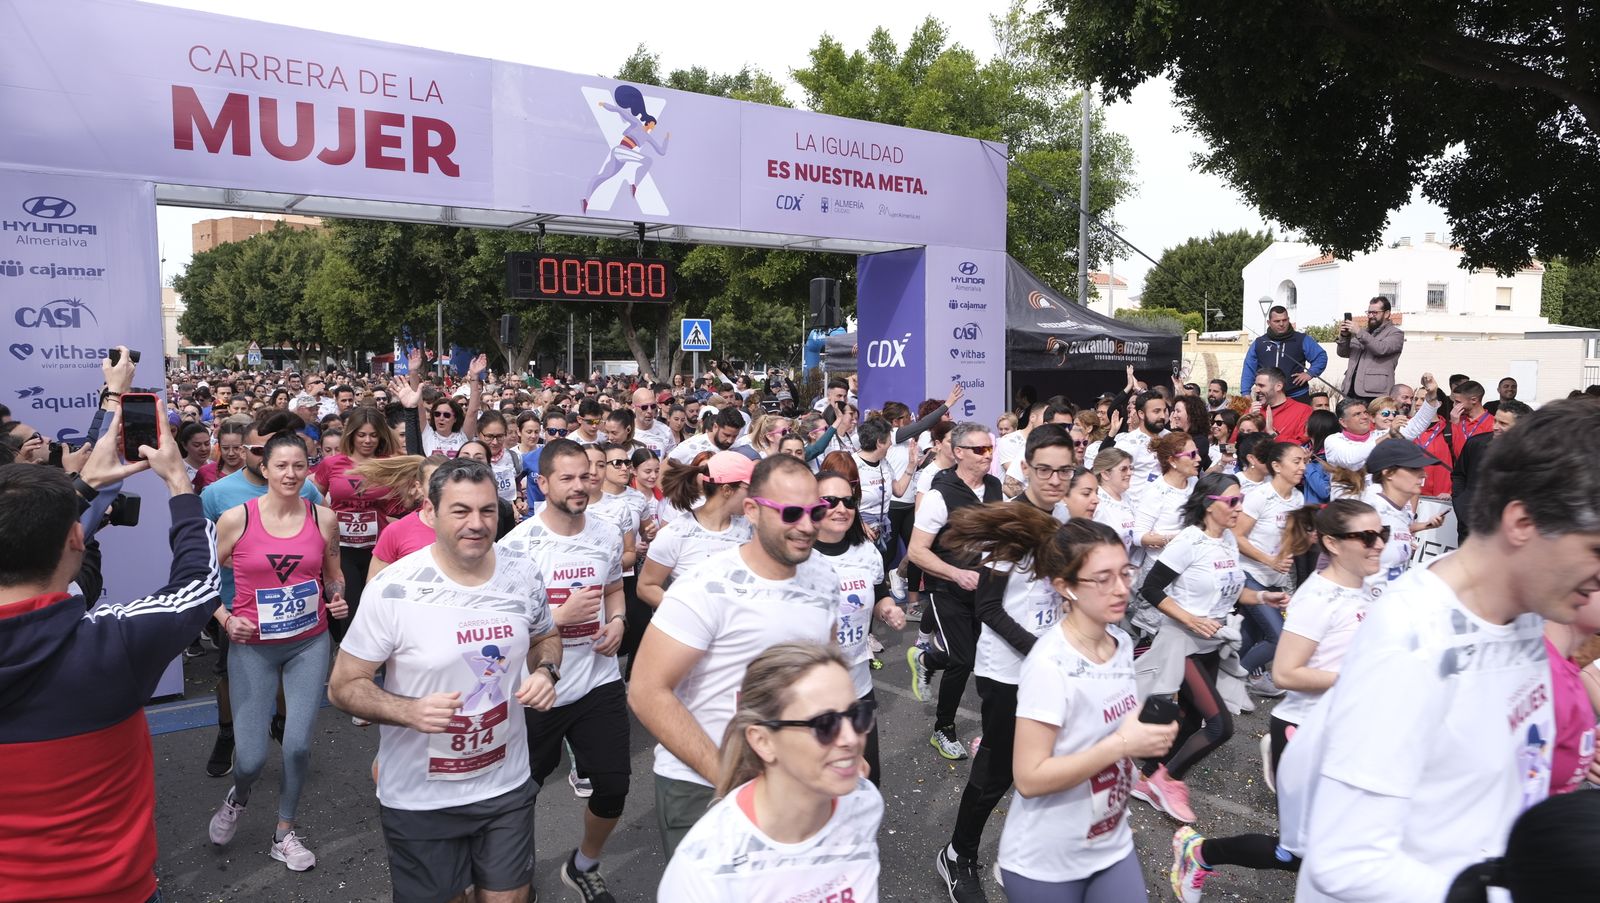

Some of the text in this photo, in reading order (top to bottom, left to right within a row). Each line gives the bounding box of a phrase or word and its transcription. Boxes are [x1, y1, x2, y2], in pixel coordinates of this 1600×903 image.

[188, 45, 444, 104] CARRERA DE LA
[172, 85, 460, 177] MUJER
[796, 132, 904, 164] LA IGUALDAD
[767, 159, 928, 195] ES NUESTRA META.
[776, 194, 804, 211] CDX
[3, 220, 97, 235] HYUNDAI
[16, 234, 88, 247] Almerialva
[29, 263, 105, 279] cajamar
[539, 258, 666, 297] 00:00:00
[951, 276, 985, 285] HYUNDAI
[960, 301, 987, 310] cajamar
[15, 306, 81, 329] CASI
[953, 326, 977, 340] CASI
[41, 345, 108, 359] vithas
[867, 336, 909, 368] CDX
[961, 350, 986, 359] vithas
[32, 392, 101, 412] aquali
[345, 523, 368, 533] 720
[554, 567, 596, 580] MUJER
[840, 579, 867, 591] UJER
[272, 599, 306, 617] 249
[456, 625, 514, 644] MUJER
[1103, 694, 1137, 723] MUJER
[451, 728, 494, 751] 814
